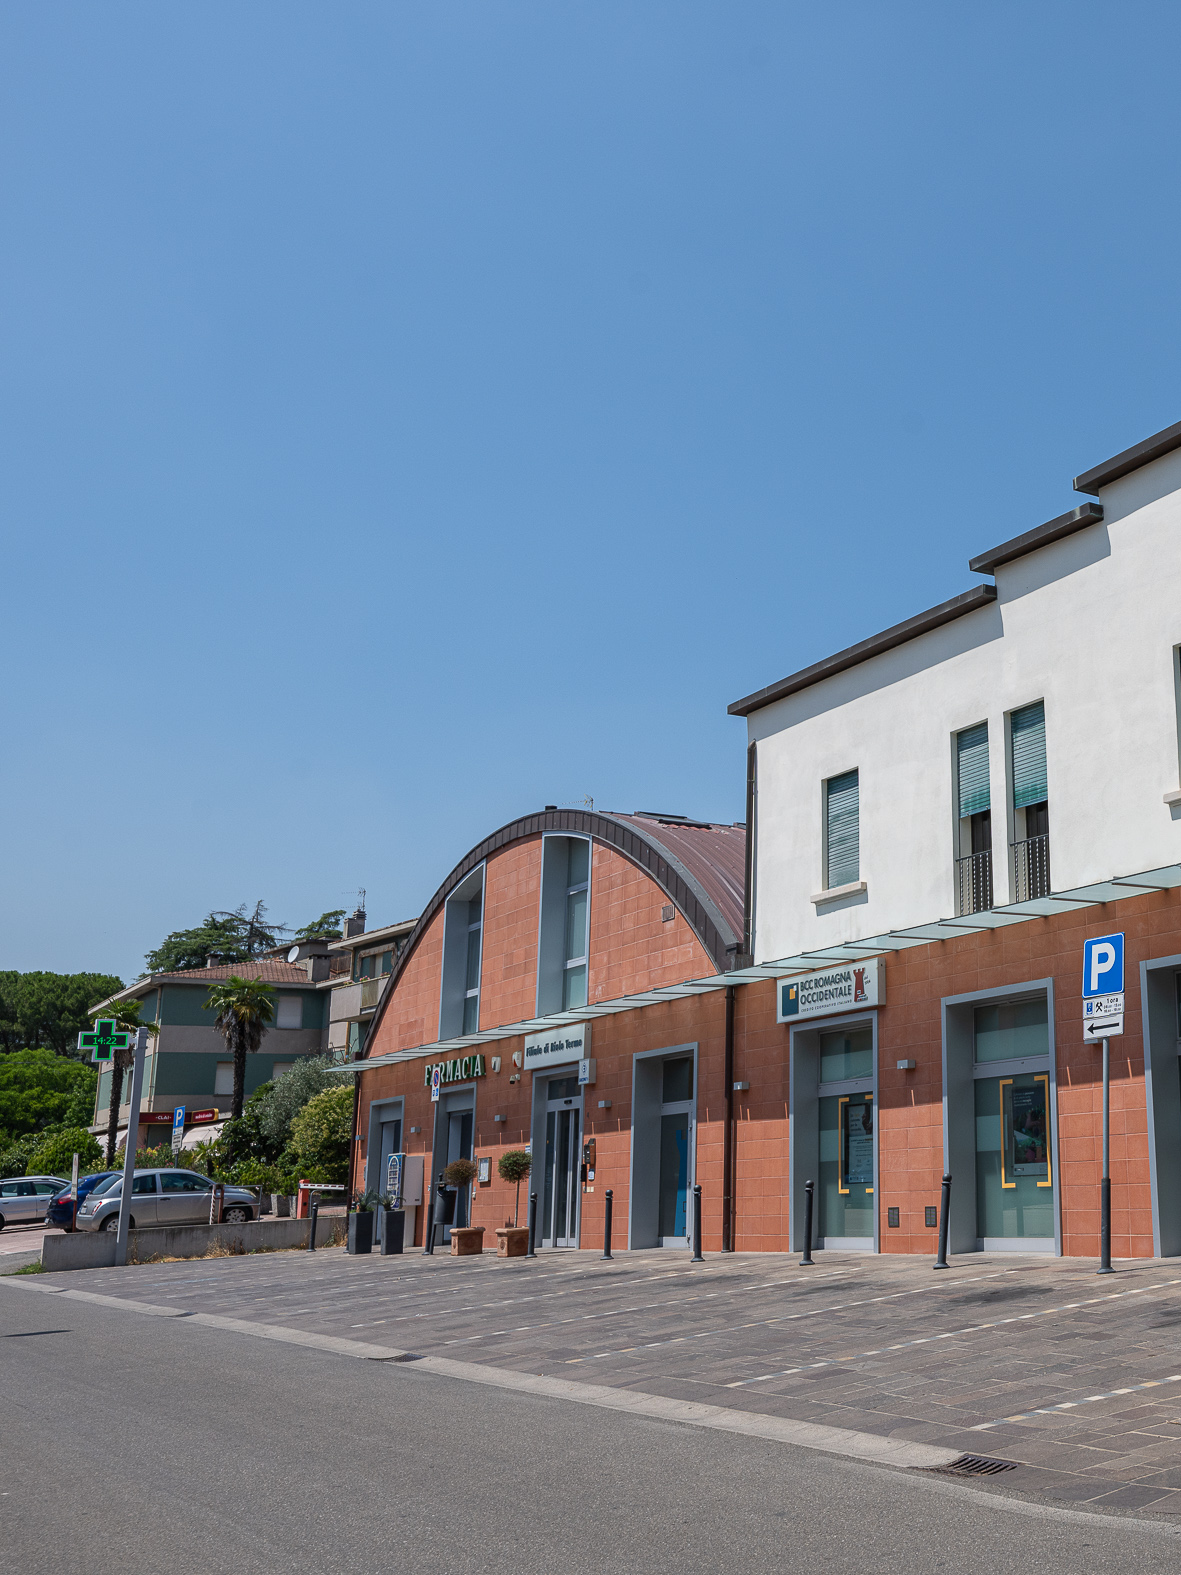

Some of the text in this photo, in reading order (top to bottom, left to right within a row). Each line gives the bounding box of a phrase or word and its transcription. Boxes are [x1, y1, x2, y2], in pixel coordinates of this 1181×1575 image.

[1091, 943, 1116, 990] P
[800, 971, 852, 992] BCC ROMAGNA
[800, 984, 852, 1005] OCCIDENTALE
[93, 1036, 117, 1045] 14:22
[526, 1045, 542, 1057] Filiale
[543, 1043, 550, 1053] di
[565, 1039, 583, 1049] Terme
[175, 1109, 183, 1126] P
